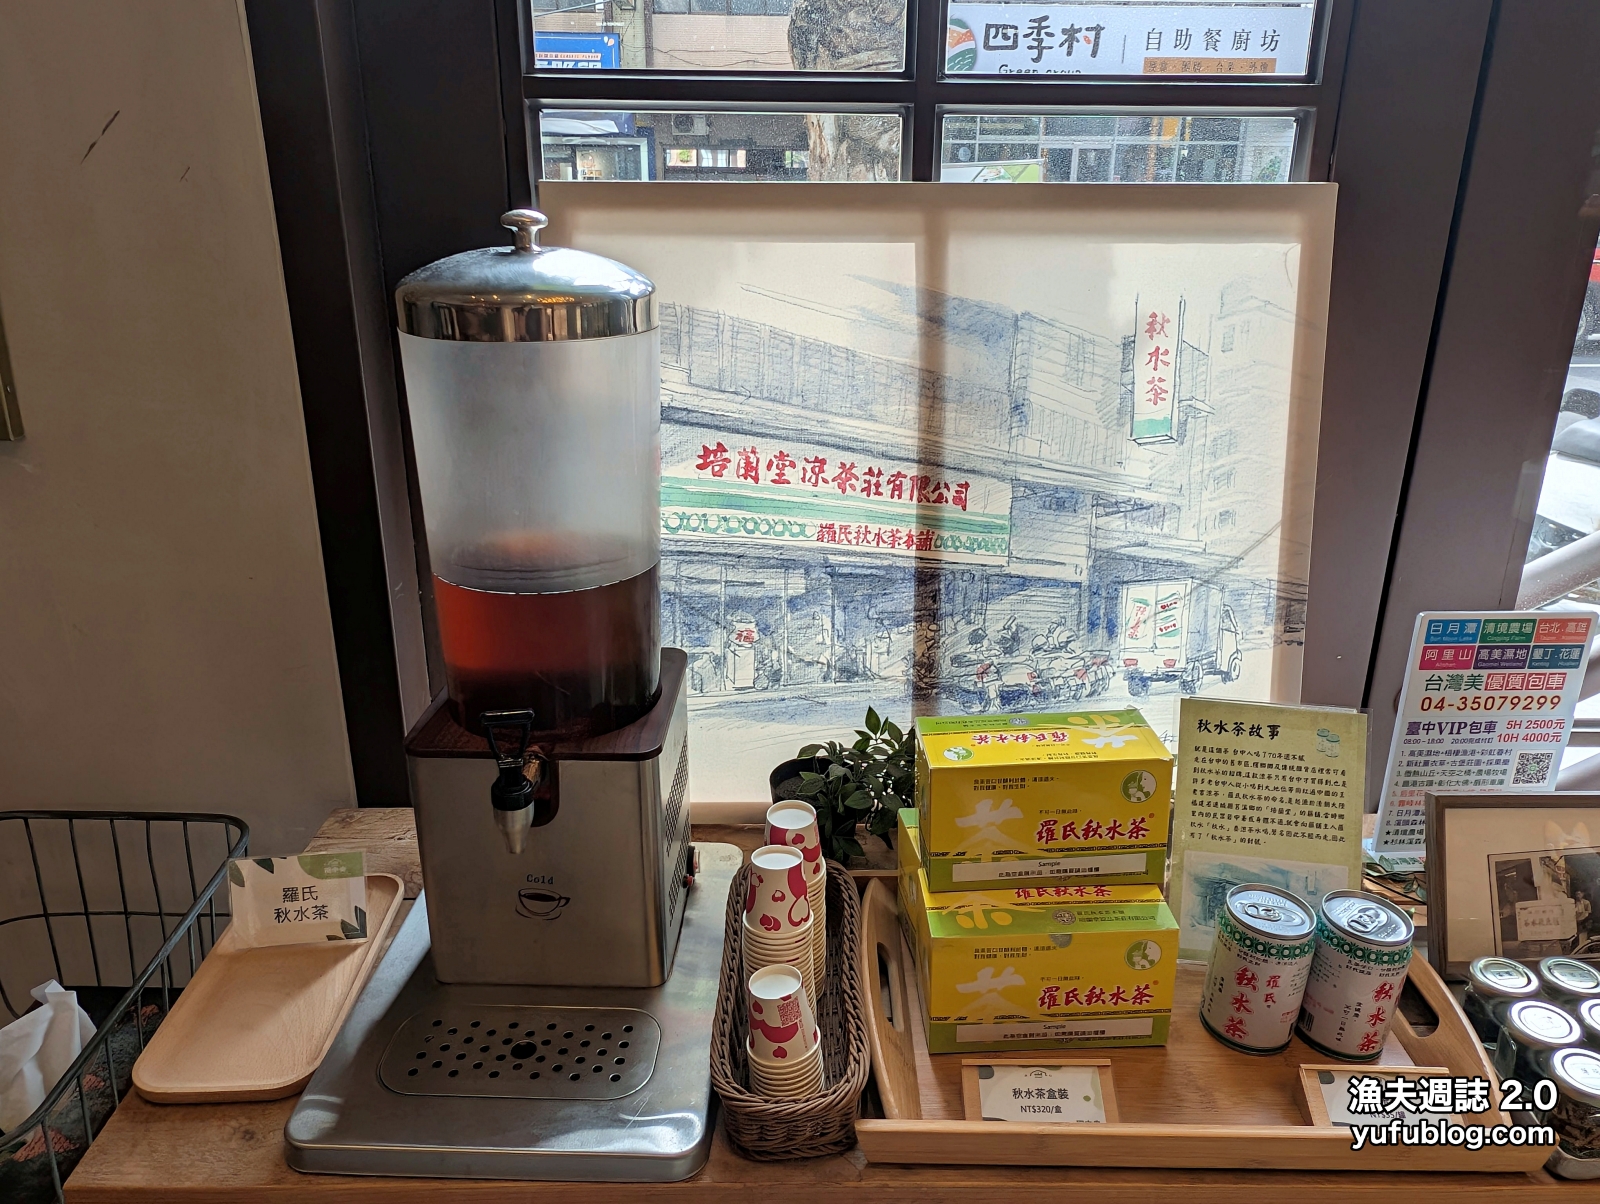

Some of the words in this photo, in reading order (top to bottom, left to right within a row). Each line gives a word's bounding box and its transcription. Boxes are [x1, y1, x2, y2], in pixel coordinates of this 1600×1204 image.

[983, 15, 1105, 63] 四季村
[1146, 27, 1281, 53] 自助餐廚坊
[1144, 311, 1171, 406] 秋水茶
[1430, 622, 1478, 634] 日月潭
[1483, 622, 1533, 634] 清境農場
[1425, 649, 1472, 661] 阿里山
[1478, 648, 1528, 661] 高美濕地
[1420, 695, 1562, 712] 04-35079299
[1197, 719, 1281, 740] 秋水茶故事
[1506, 720, 1523, 730] 5H
[1526, 719, 1566, 730] 2500元
[1497, 733, 1519, 743] 10H
[1522, 732, 1562, 743] 4000元
[1036, 817, 1150, 845] 羅氏秋水茶
[1038, 860, 1061, 868] Sample
[526, 874, 554, 885] Cold
[282, 885, 319, 903] 羅氏
[274, 904, 329, 924] 秋水茶
[1038, 984, 1154, 1011] 羅氏秋水茶
[1224, 965, 1259, 1040] 秋水茶
[1358, 980, 1395, 1052] 秋水茶
[1012, 1088, 1070, 1100] 秋水茶盒裝
[1020, 1105, 1063, 1115] NT$320/盒
